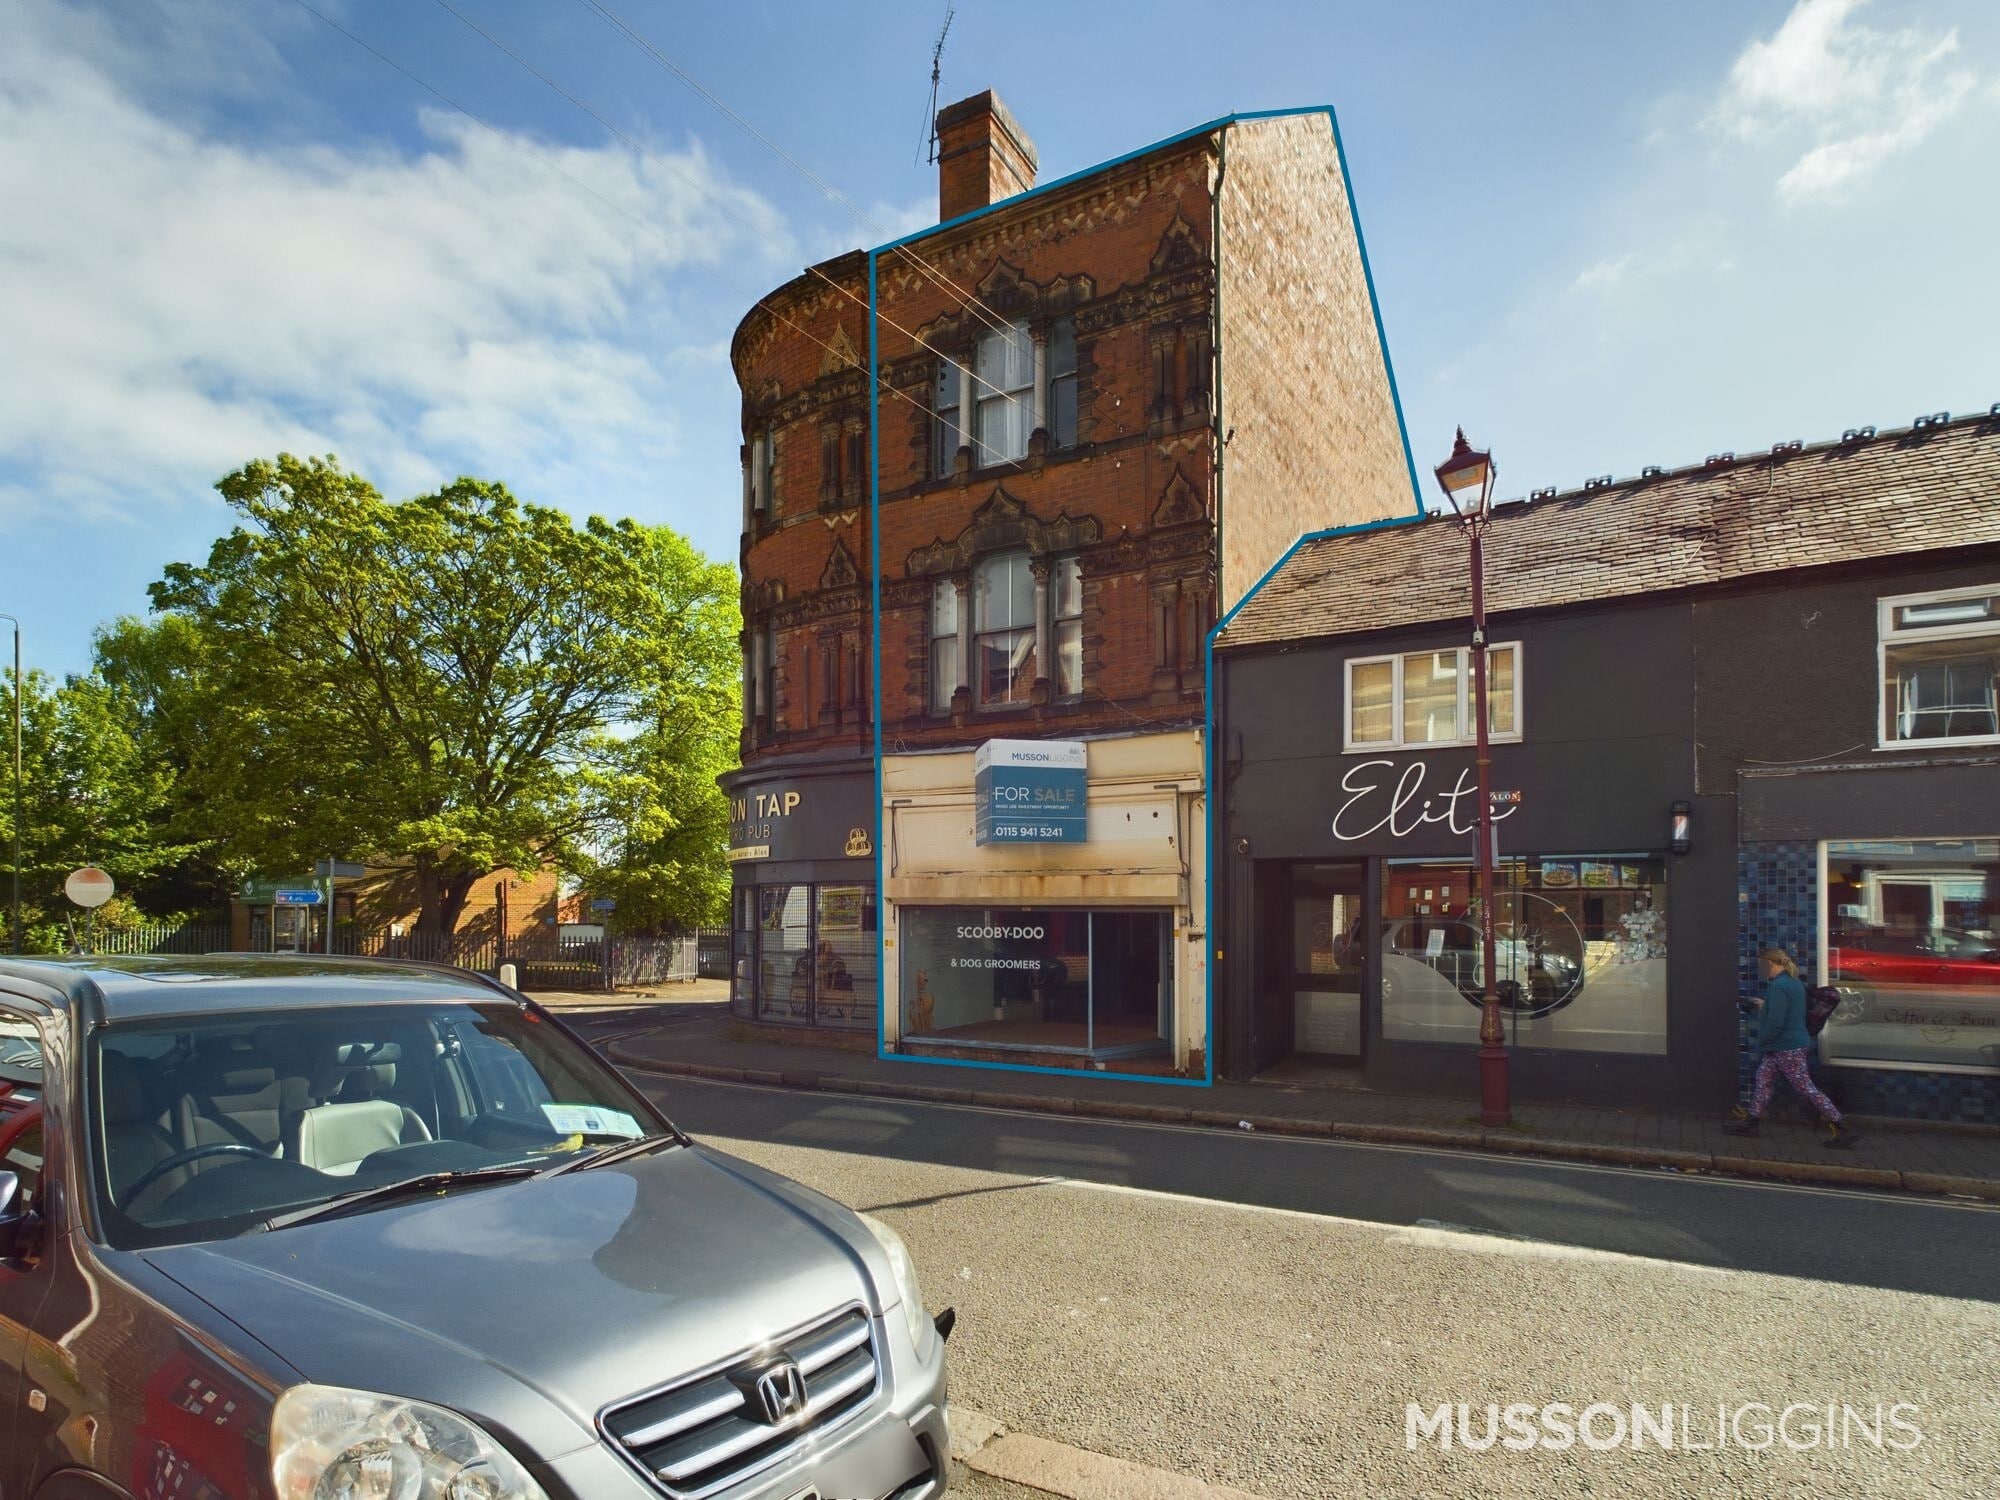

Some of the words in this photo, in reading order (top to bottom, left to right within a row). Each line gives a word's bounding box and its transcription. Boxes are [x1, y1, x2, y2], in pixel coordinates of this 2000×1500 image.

[994, 786, 1030, 802] FOR
[1034, 788, 1075, 802] SALE
[730, 798, 746, 823] ON
[756, 792, 800, 817] TAP
[748, 824, 770, 839] PUB
[995, 827, 1018, 837] 0115
[1020, 827, 1038, 837] 941
[1040, 827, 1063, 838] 5241
[956, 926, 1045, 939] SCOOBY-DOO
[950, 958, 958, 968] &
[960, 958, 982, 968] DOG
[984, 959, 1041, 970] GROOMERS
